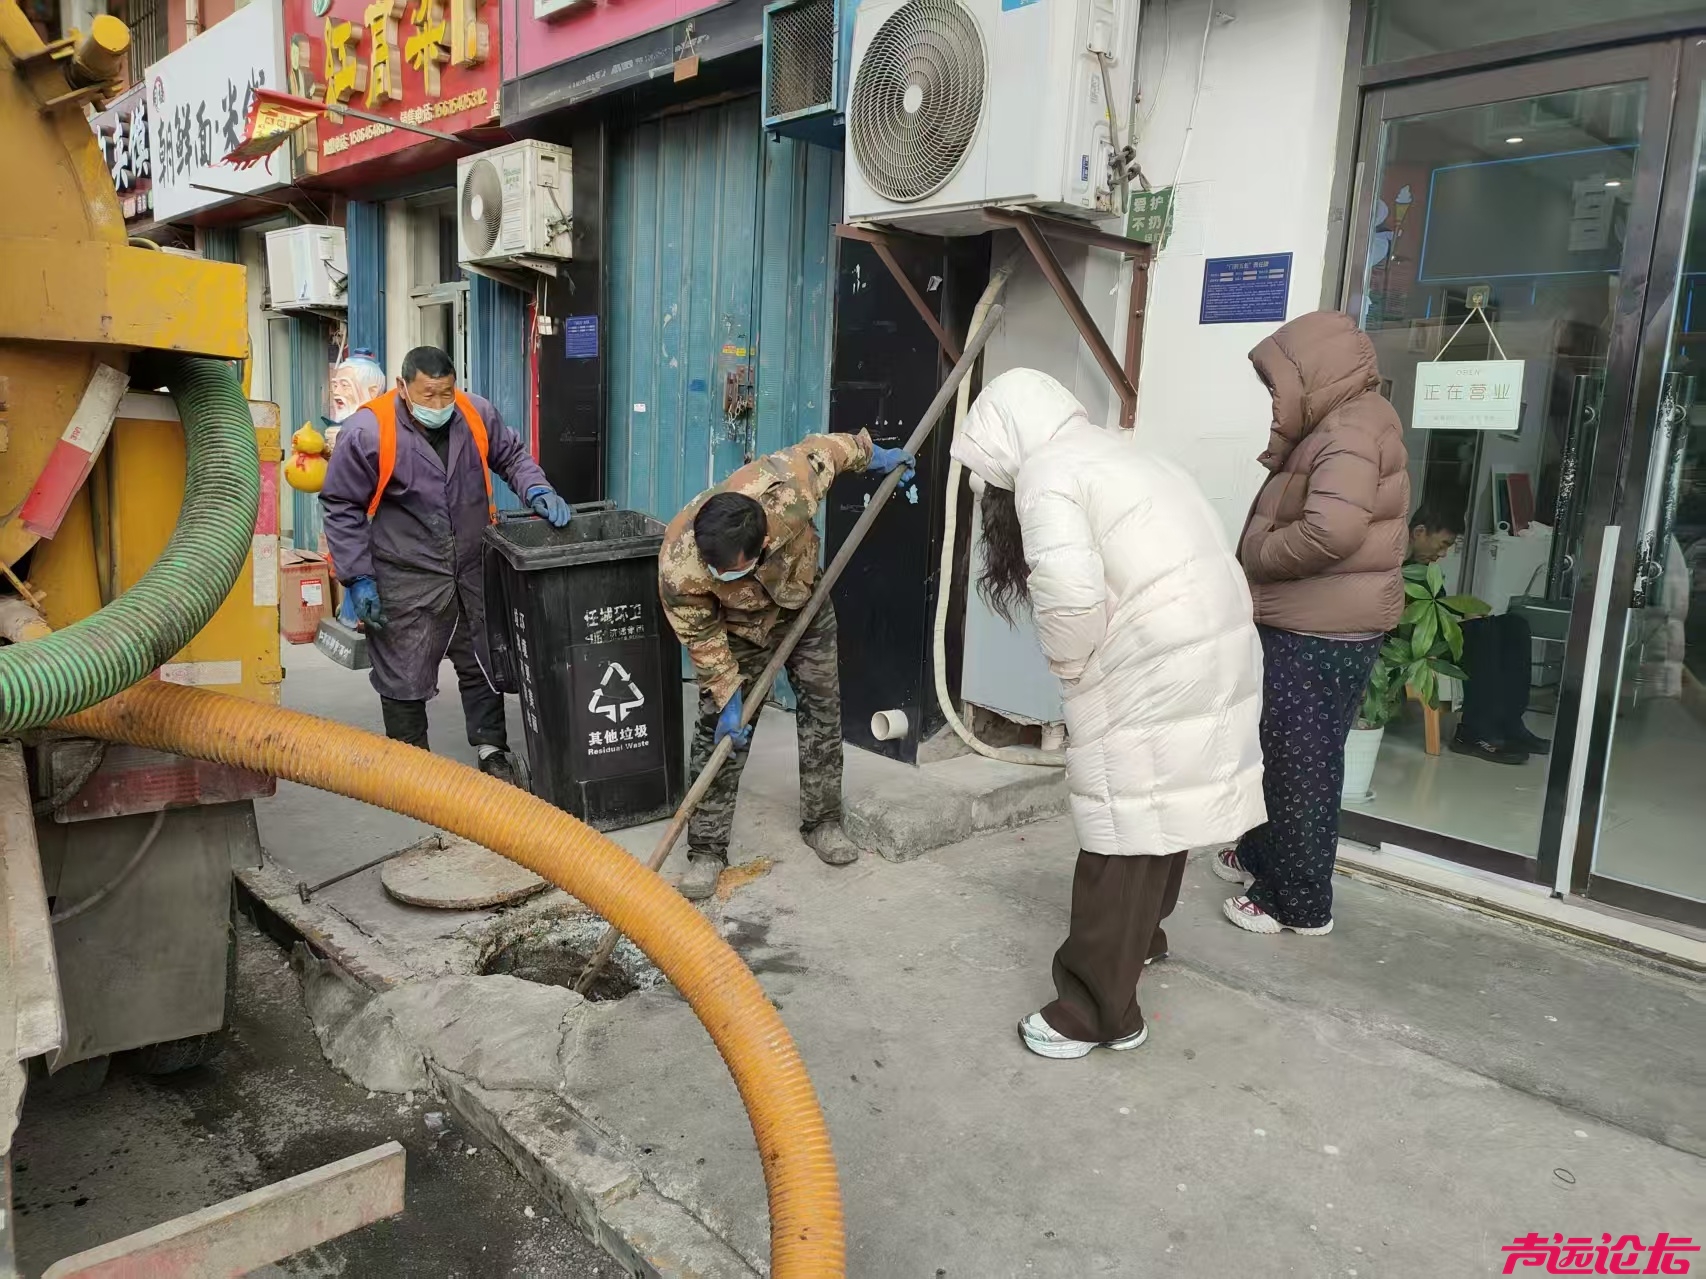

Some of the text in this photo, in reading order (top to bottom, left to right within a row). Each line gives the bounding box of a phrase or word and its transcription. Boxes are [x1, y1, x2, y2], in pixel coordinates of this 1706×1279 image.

[1424, 383, 1510, 400] 正在营业
[588, 724, 648, 746] 其他垃圾
[588, 740, 649, 755] Residual Waste
